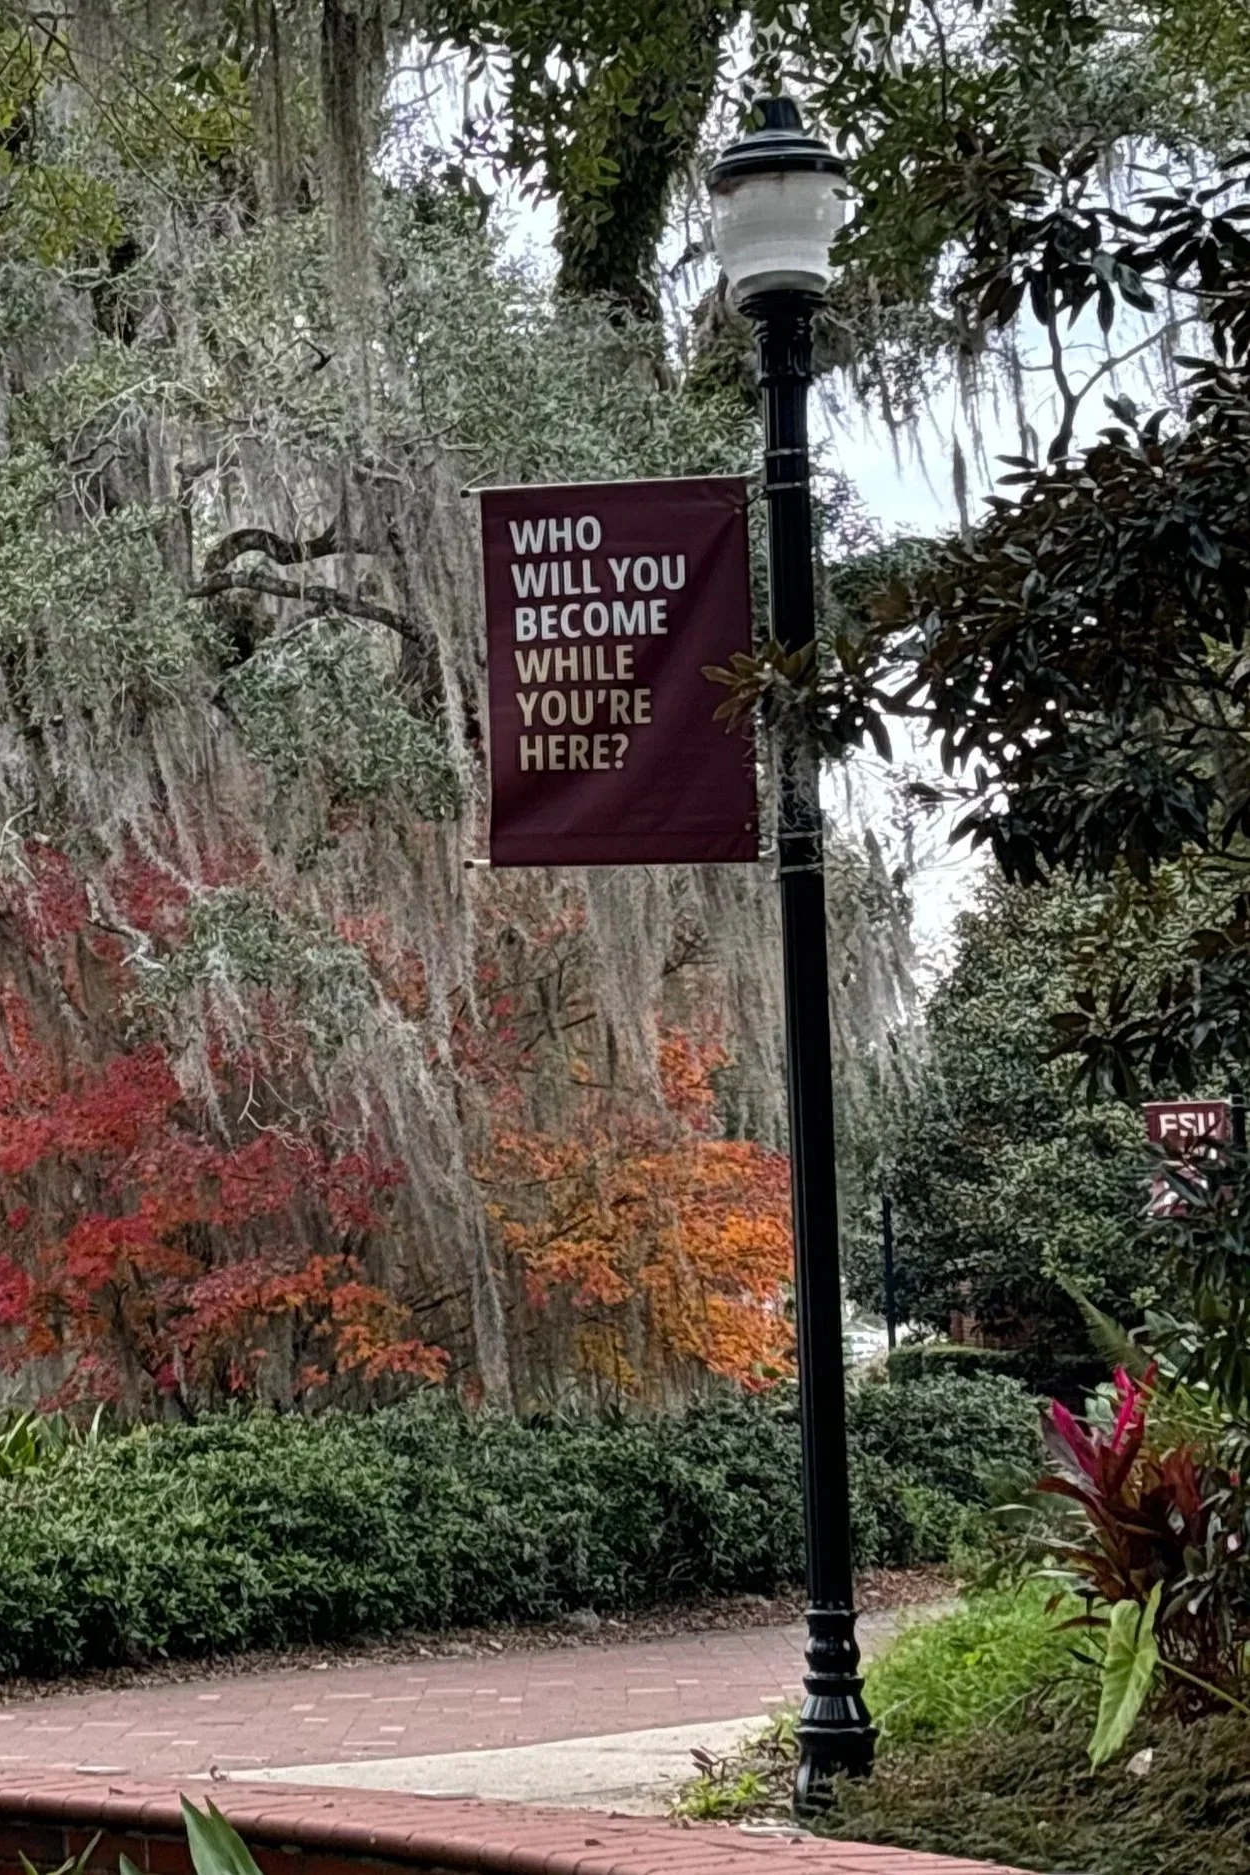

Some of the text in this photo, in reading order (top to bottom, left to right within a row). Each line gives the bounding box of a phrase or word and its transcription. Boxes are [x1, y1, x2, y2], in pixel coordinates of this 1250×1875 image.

[508, 515, 602, 555] WHO
[511, 554, 687, 598] WILL YOU
[515, 598, 669, 642] BECOME
[514, 644, 635, 684] WHILE
[515, 687, 652, 727] YOU'RE
[519, 733, 630, 772] HERE?
[1158, 1112, 1217, 1138] FSU
